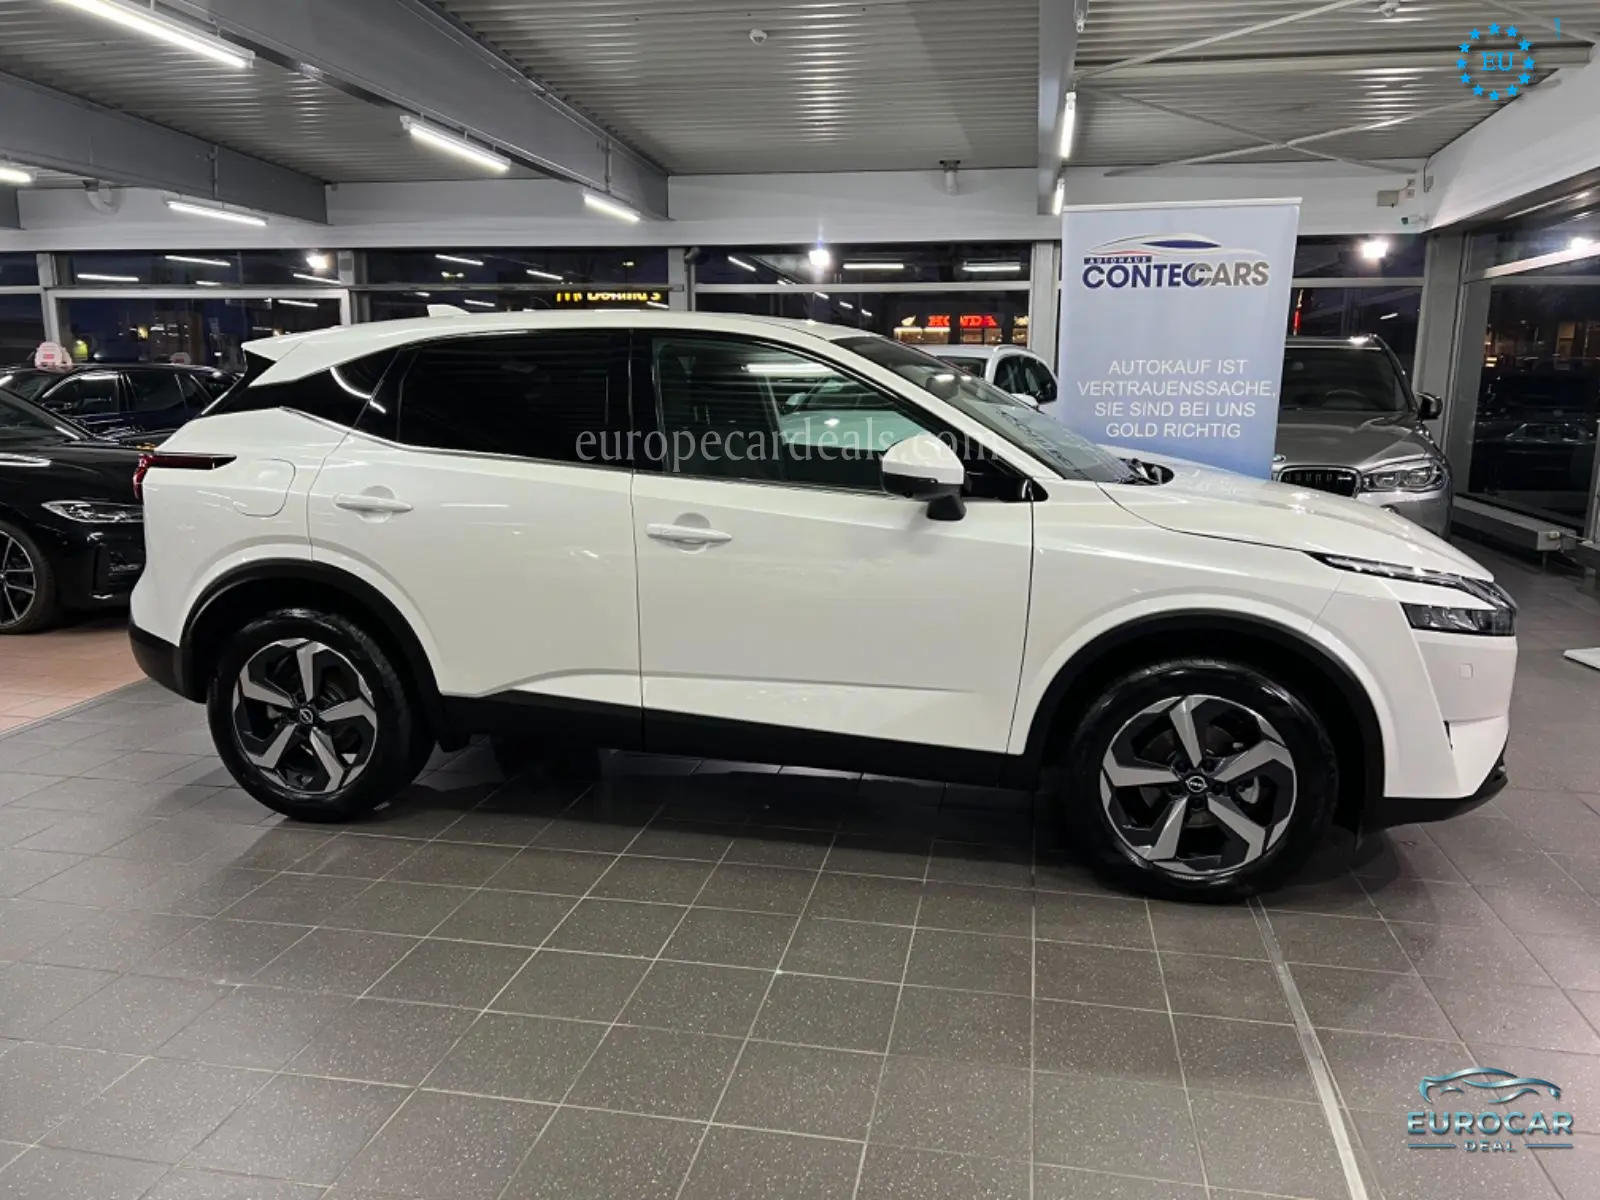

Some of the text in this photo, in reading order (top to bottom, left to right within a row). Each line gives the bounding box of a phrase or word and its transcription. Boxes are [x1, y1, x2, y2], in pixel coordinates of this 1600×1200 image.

[1108, 359, 1248, 375] AUTOKAUF IST
[1077, 380, 1277, 398] VERTRAUENSSACHE,
[1094, 402, 1256, 417] SIE SIND BEI UNS
[1105, 422, 1241, 438] GOLD RICHTIG
